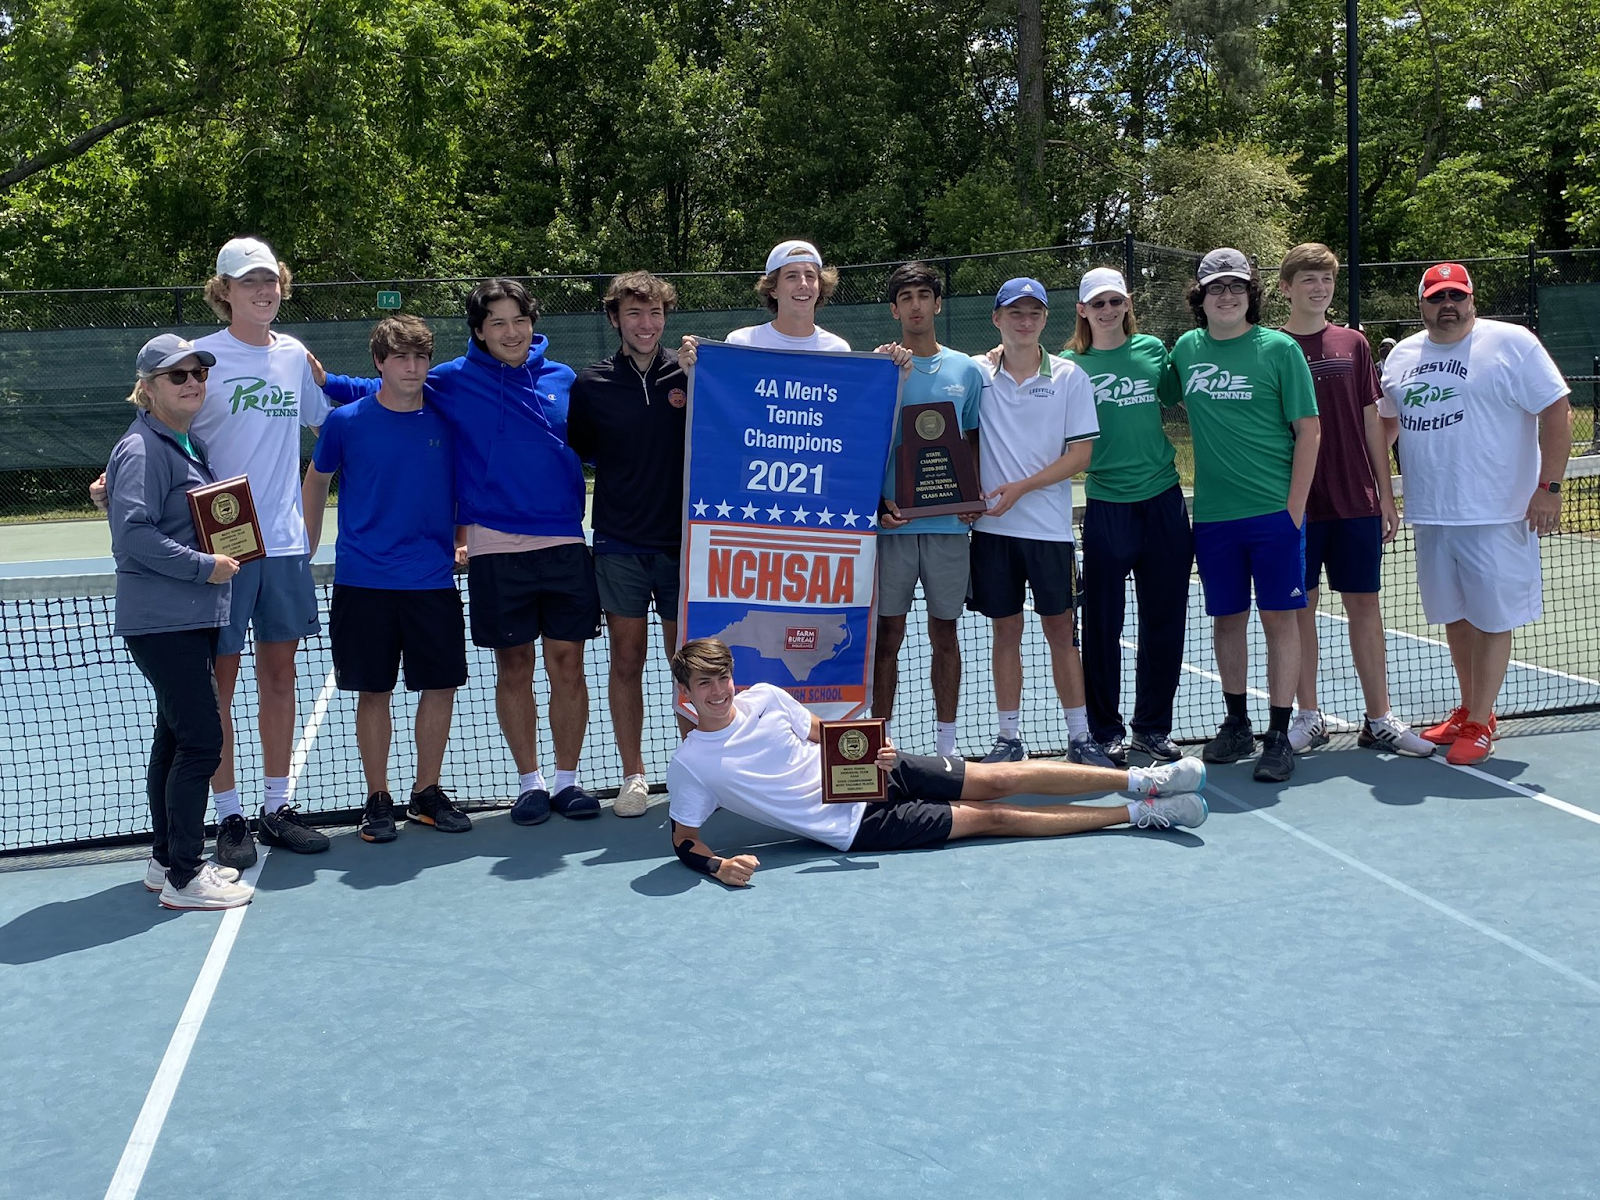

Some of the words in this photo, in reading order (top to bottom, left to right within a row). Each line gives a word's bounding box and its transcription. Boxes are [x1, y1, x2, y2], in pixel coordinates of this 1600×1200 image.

[383, 295, 395, 305] 14
[1400, 359, 1468, 384] Leesville
[754, 378, 779, 398] 4A
[784, 380, 838, 403] Men's
[1116, 394, 1156, 407] TENNIS
[1209, 391, 1253, 400] TENNIS
[766, 404, 824, 427] Tennis
[744, 428, 843, 454] Champions
[920, 457, 948, 465] CHAMPION
[746, 460, 824, 495] 2021
[707, 548, 855, 604] NCHSAA
[808, 686, 843, 701] SCHOOL
